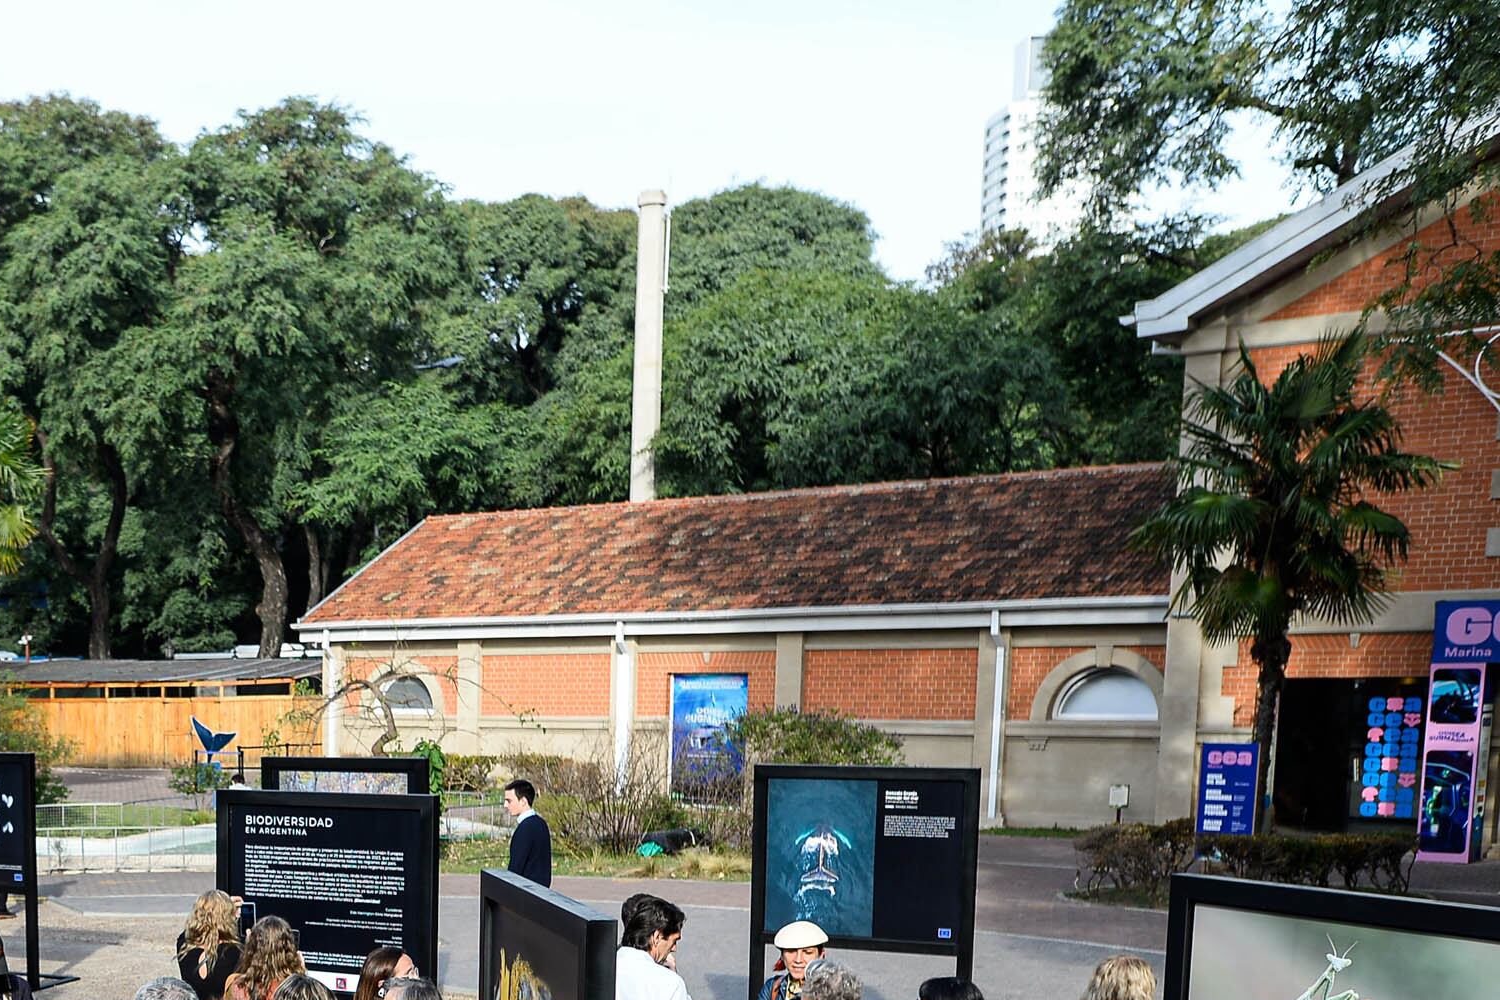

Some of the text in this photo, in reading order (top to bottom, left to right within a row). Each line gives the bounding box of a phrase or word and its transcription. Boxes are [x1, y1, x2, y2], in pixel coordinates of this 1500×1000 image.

[1444, 646, 1492, 657] Marina
[245, 814, 333, 828] BIODIVERSIDAD
[245, 826, 308, 836] EN ARGENTINA
